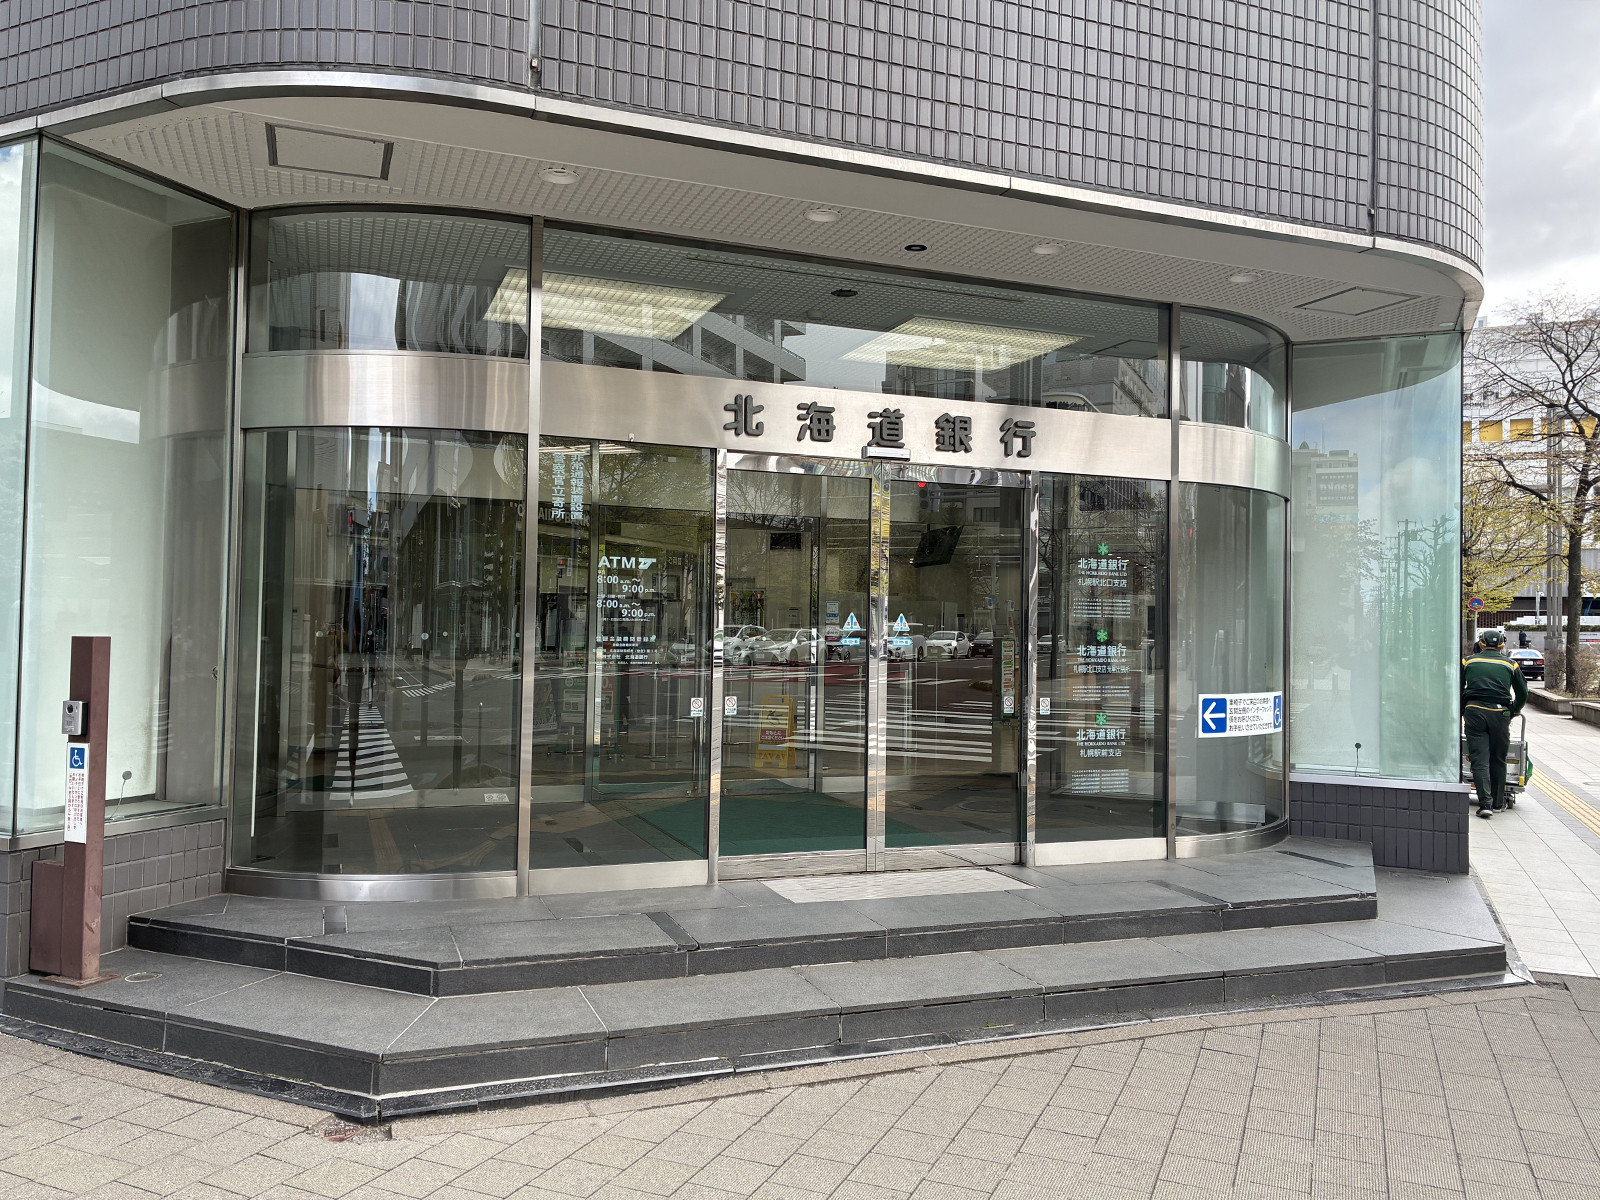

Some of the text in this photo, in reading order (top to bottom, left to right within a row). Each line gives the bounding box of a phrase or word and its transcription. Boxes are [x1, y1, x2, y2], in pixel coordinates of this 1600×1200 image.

[723, 394, 1036, 458] 北海道銀行
[552, 453, 566, 520] 警察官立寄所
[570, 454, 584, 520] 非常通報装置設置
[598, 556, 636, 569] ATM
[1078, 557, 1128, 571] 北海道銀行
[597, 575, 618, 584] 8:00
[1078, 577, 1127, 588] 札幌駅北口支店
[622, 585, 644, 594] 9:00
[596, 600, 618, 608] 8:00
[622, 609, 644, 617] 9:00
[1077, 645, 1127, 657] 北海道銀行
[1076, 728, 1126, 740] 北海道銀行
[1079, 749, 1122, 758] 札幌駅前支店
